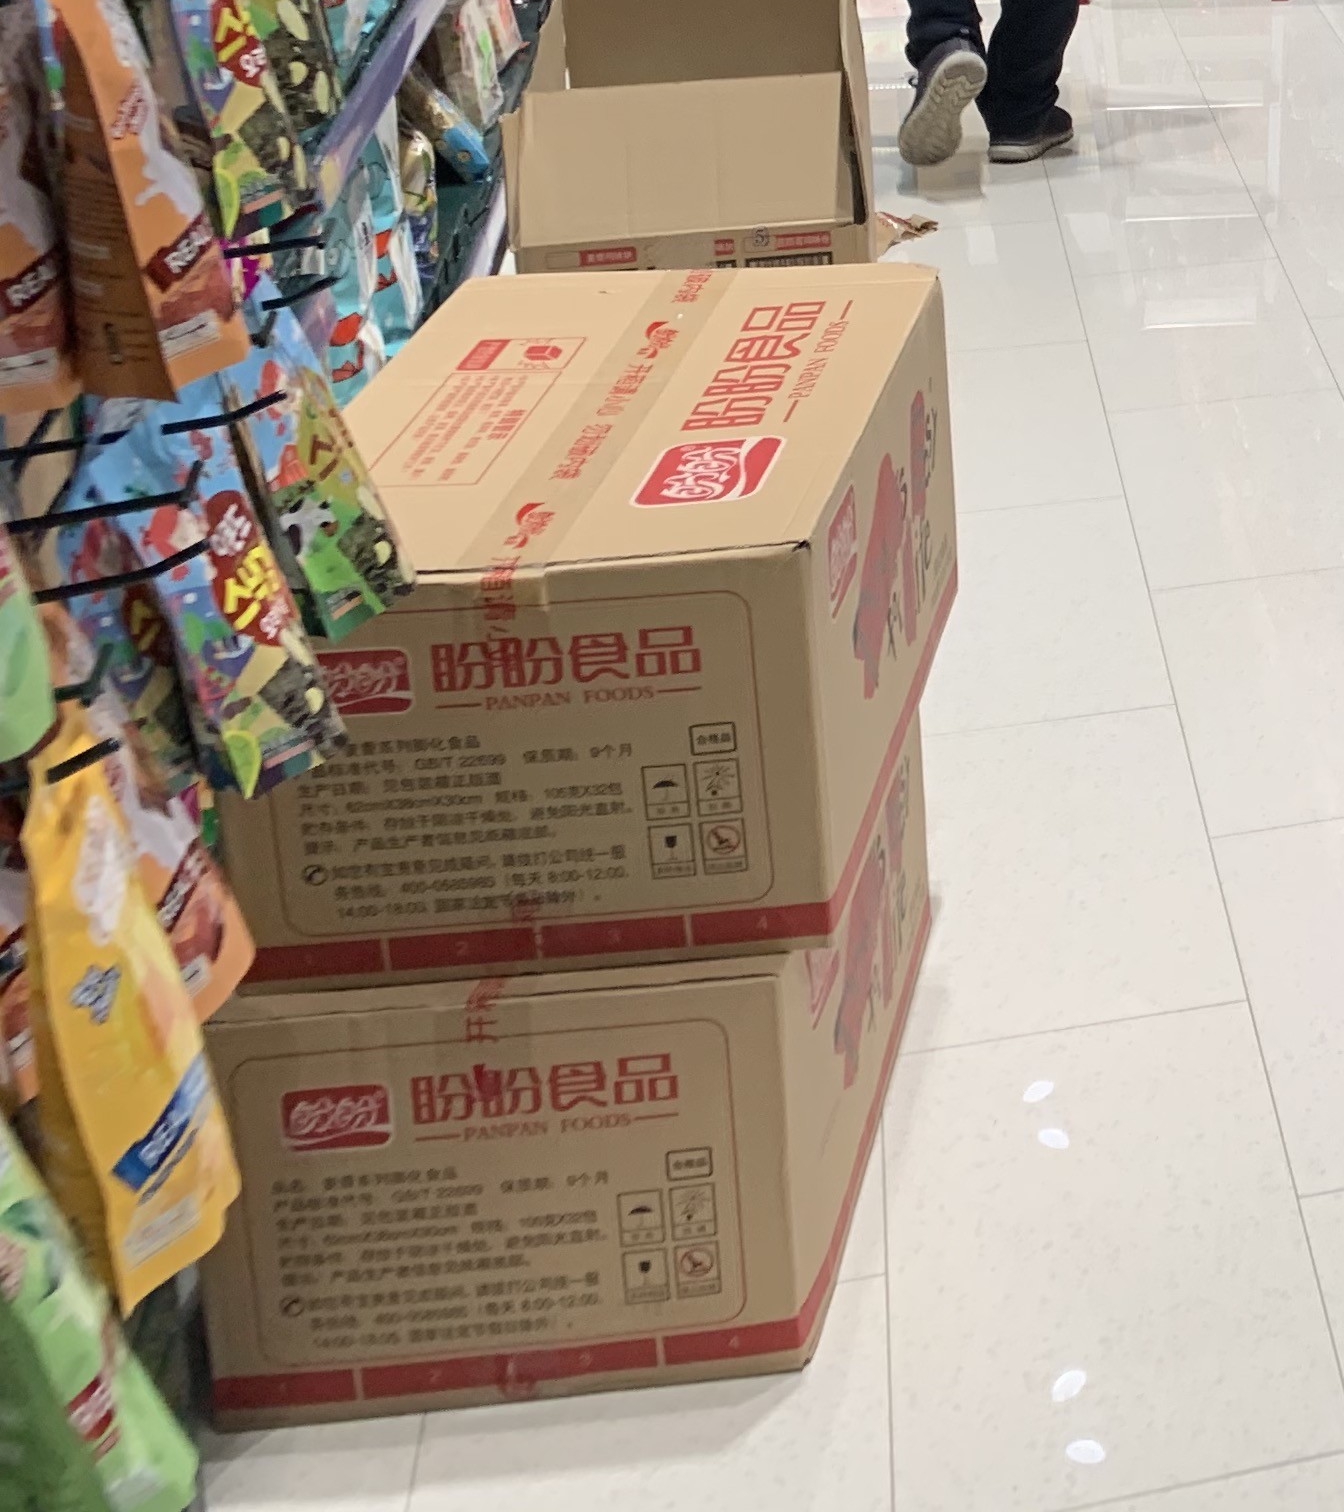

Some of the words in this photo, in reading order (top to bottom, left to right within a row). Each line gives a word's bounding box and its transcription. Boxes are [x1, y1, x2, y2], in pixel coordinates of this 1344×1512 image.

[680, 300, 827, 432] 盼盼食品
[431, 624, 702, 695] 盼盼食品
[485, 691, 578, 711] PANPAN
[582, 686, 656, 705] FOODS
[411, 1053, 680, 1126] 盼盼食品
[464, 1120, 550, 1141] PANPAN
[560, 1113, 633, 1134] FOODS
